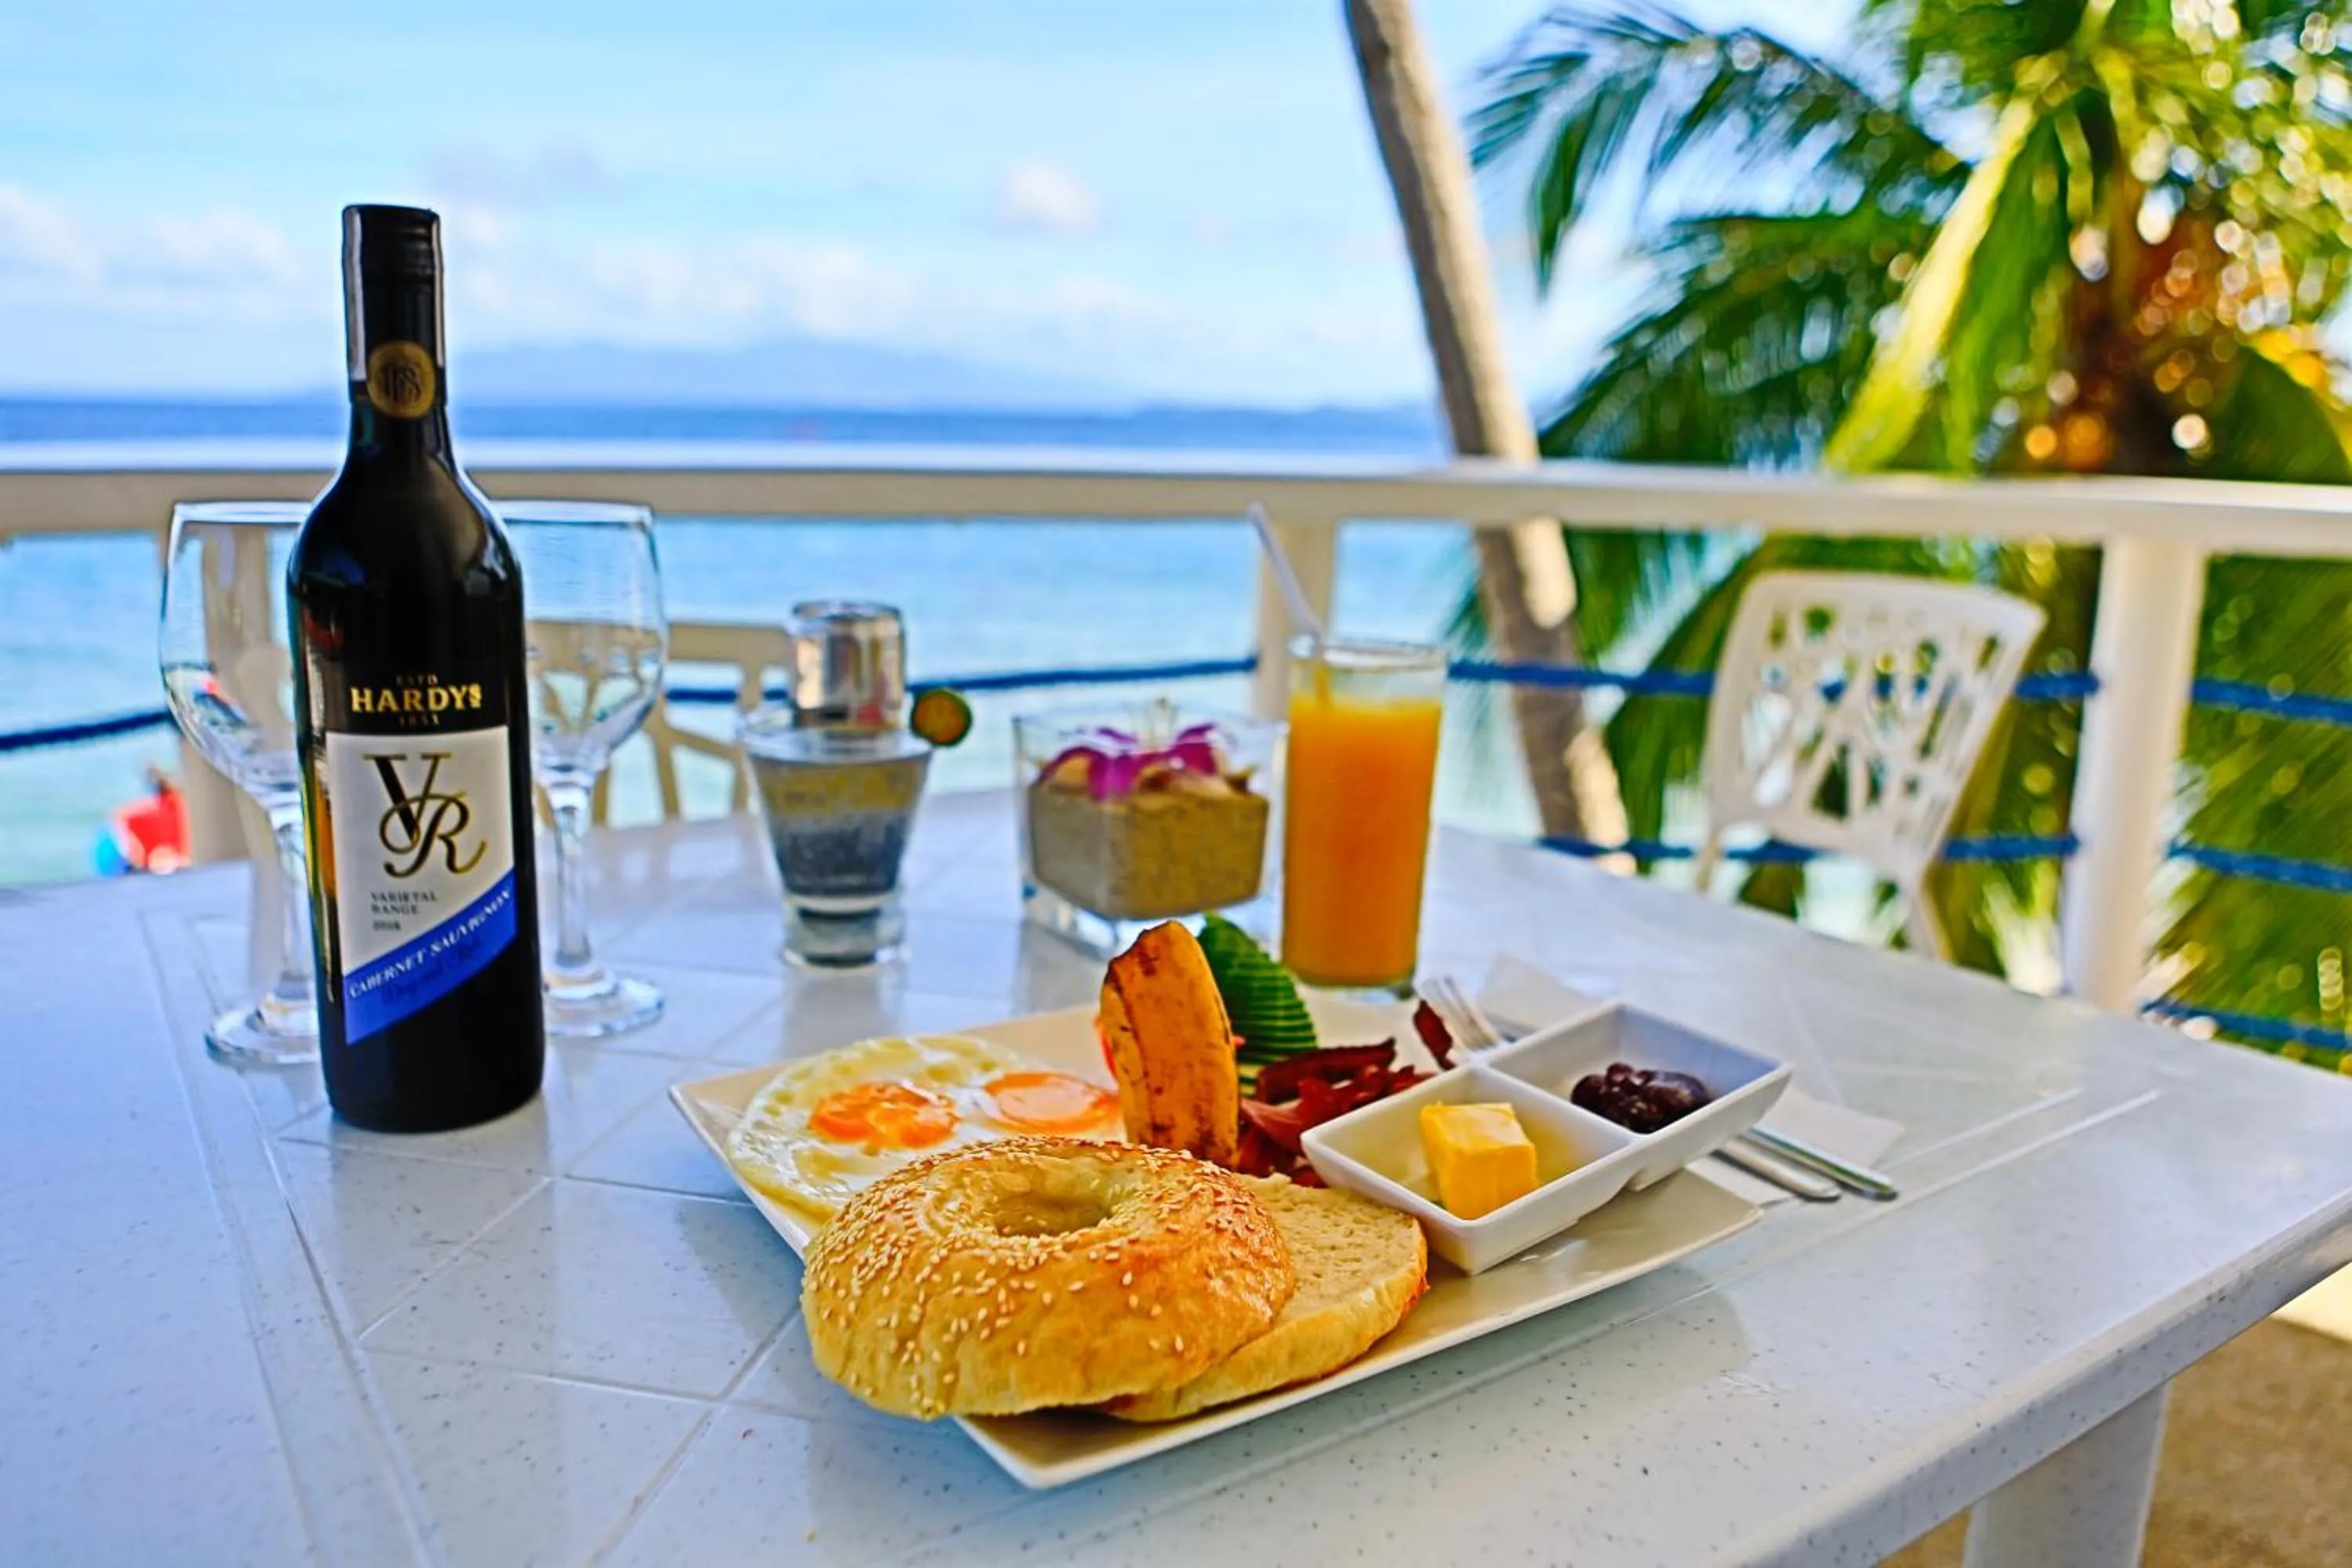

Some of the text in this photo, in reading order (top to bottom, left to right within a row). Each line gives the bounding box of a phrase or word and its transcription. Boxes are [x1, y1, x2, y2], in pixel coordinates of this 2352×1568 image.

[350, 682, 483, 713] HARDYS
[349, 946, 427, 998] CABERNET
[429, 887, 511, 956] SAUVIGNON
